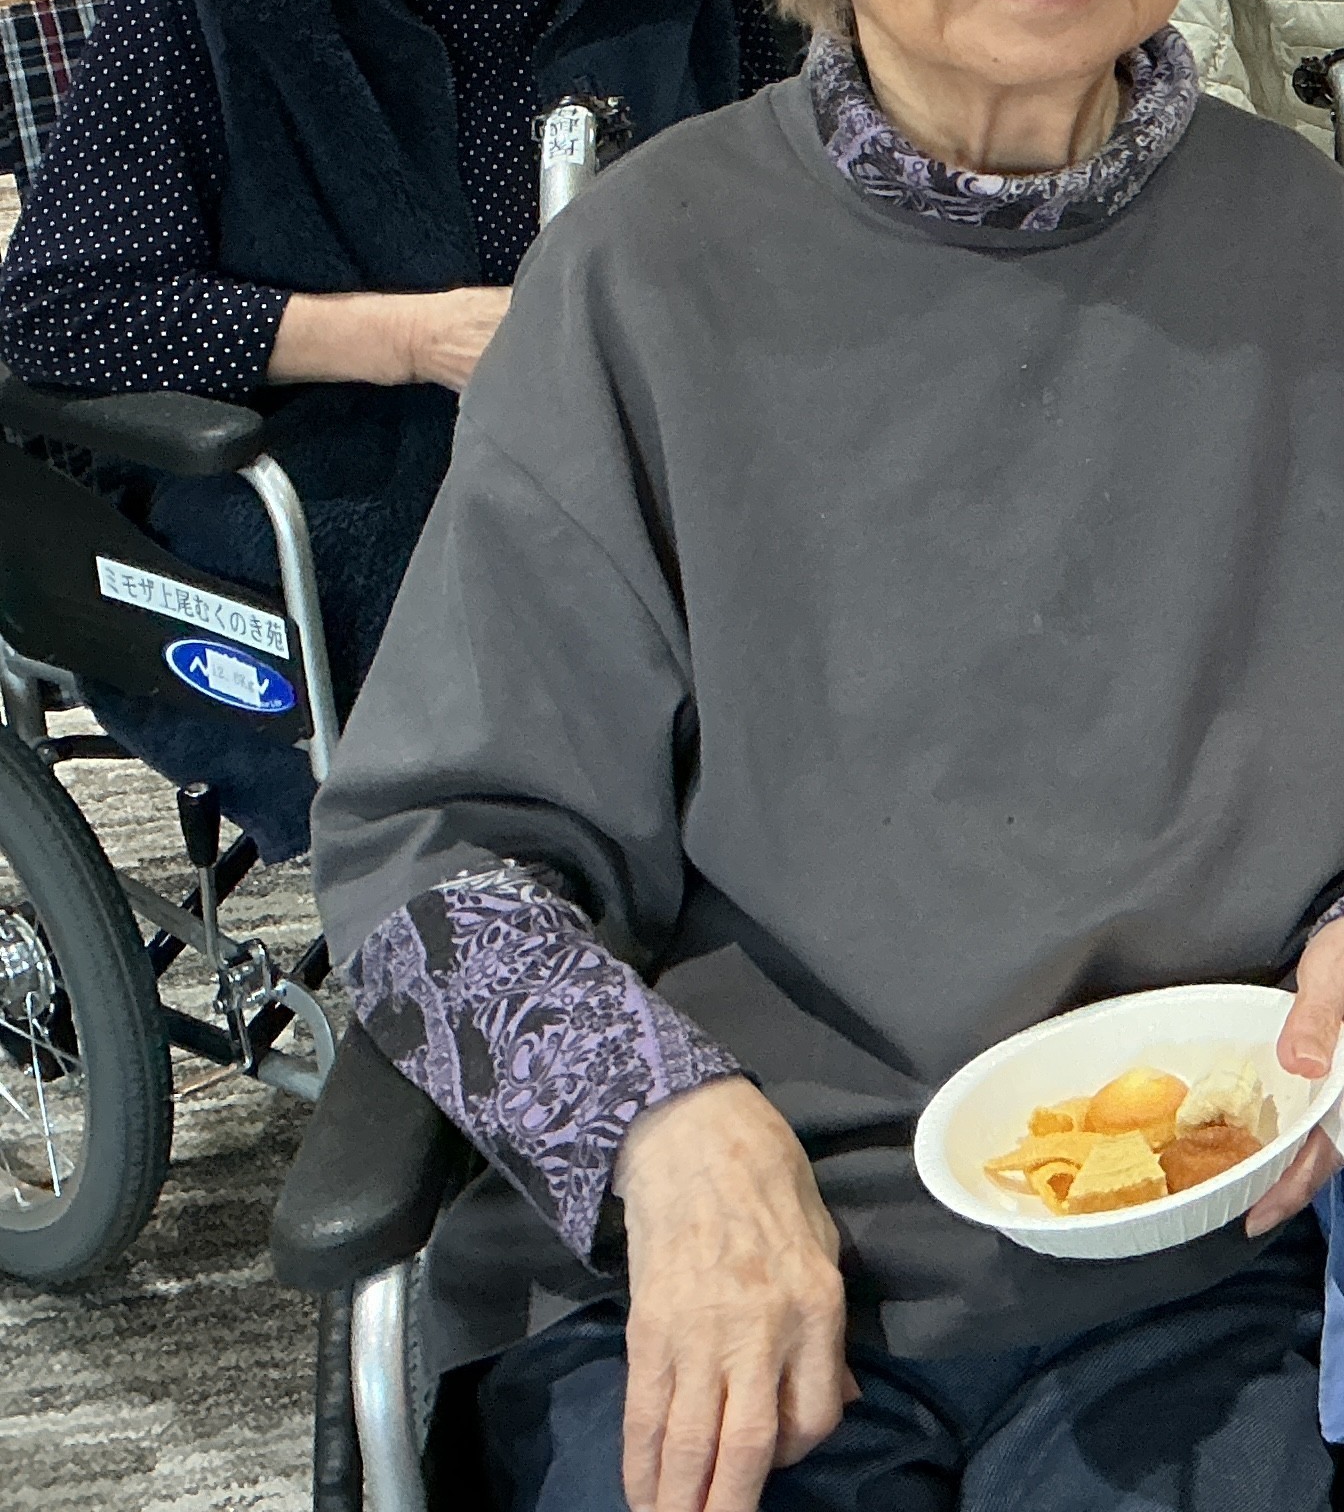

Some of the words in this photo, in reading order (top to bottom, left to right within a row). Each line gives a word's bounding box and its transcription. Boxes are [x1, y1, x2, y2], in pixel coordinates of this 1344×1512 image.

[104, 566, 285, 653] ミモザ上尾むくのき苑
